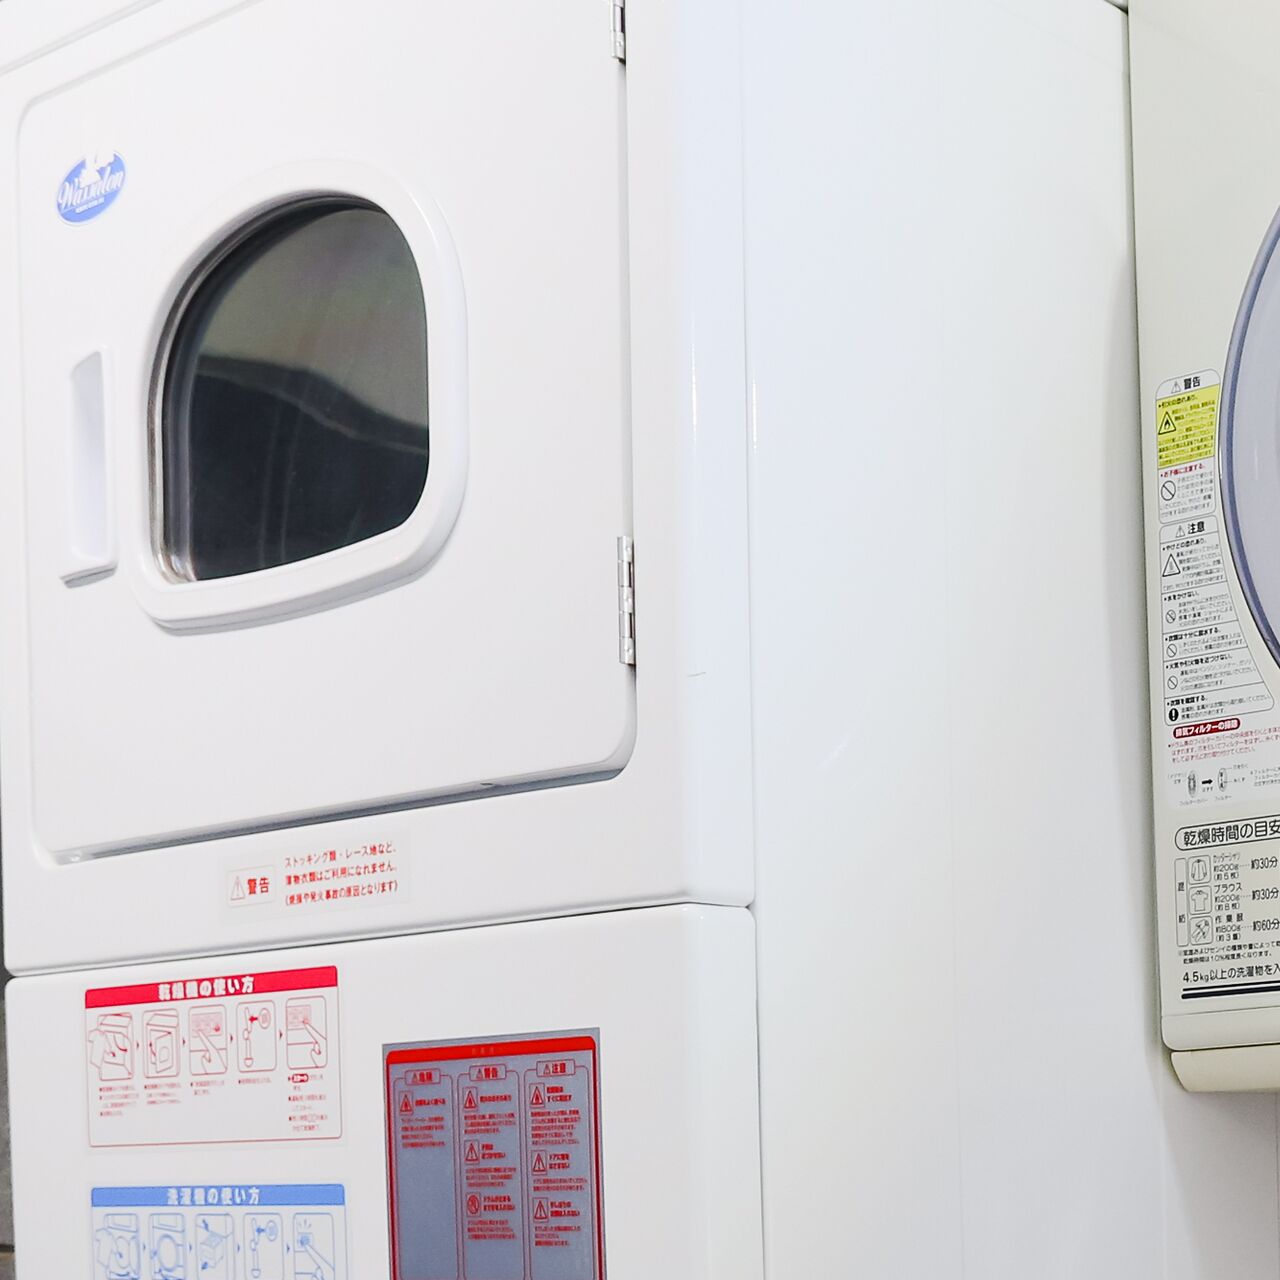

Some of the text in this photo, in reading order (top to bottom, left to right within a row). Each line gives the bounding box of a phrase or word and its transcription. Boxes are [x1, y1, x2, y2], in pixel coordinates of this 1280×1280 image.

[1183, 377, 1201, 390] 警告
[1188, 521, 1205, 535] 注意
[247, 877, 270, 895] 警告
[158, 976, 255, 1000] 乾燥機の使い方
[167, 1188, 260, 1205] 洗濯機の使い方
